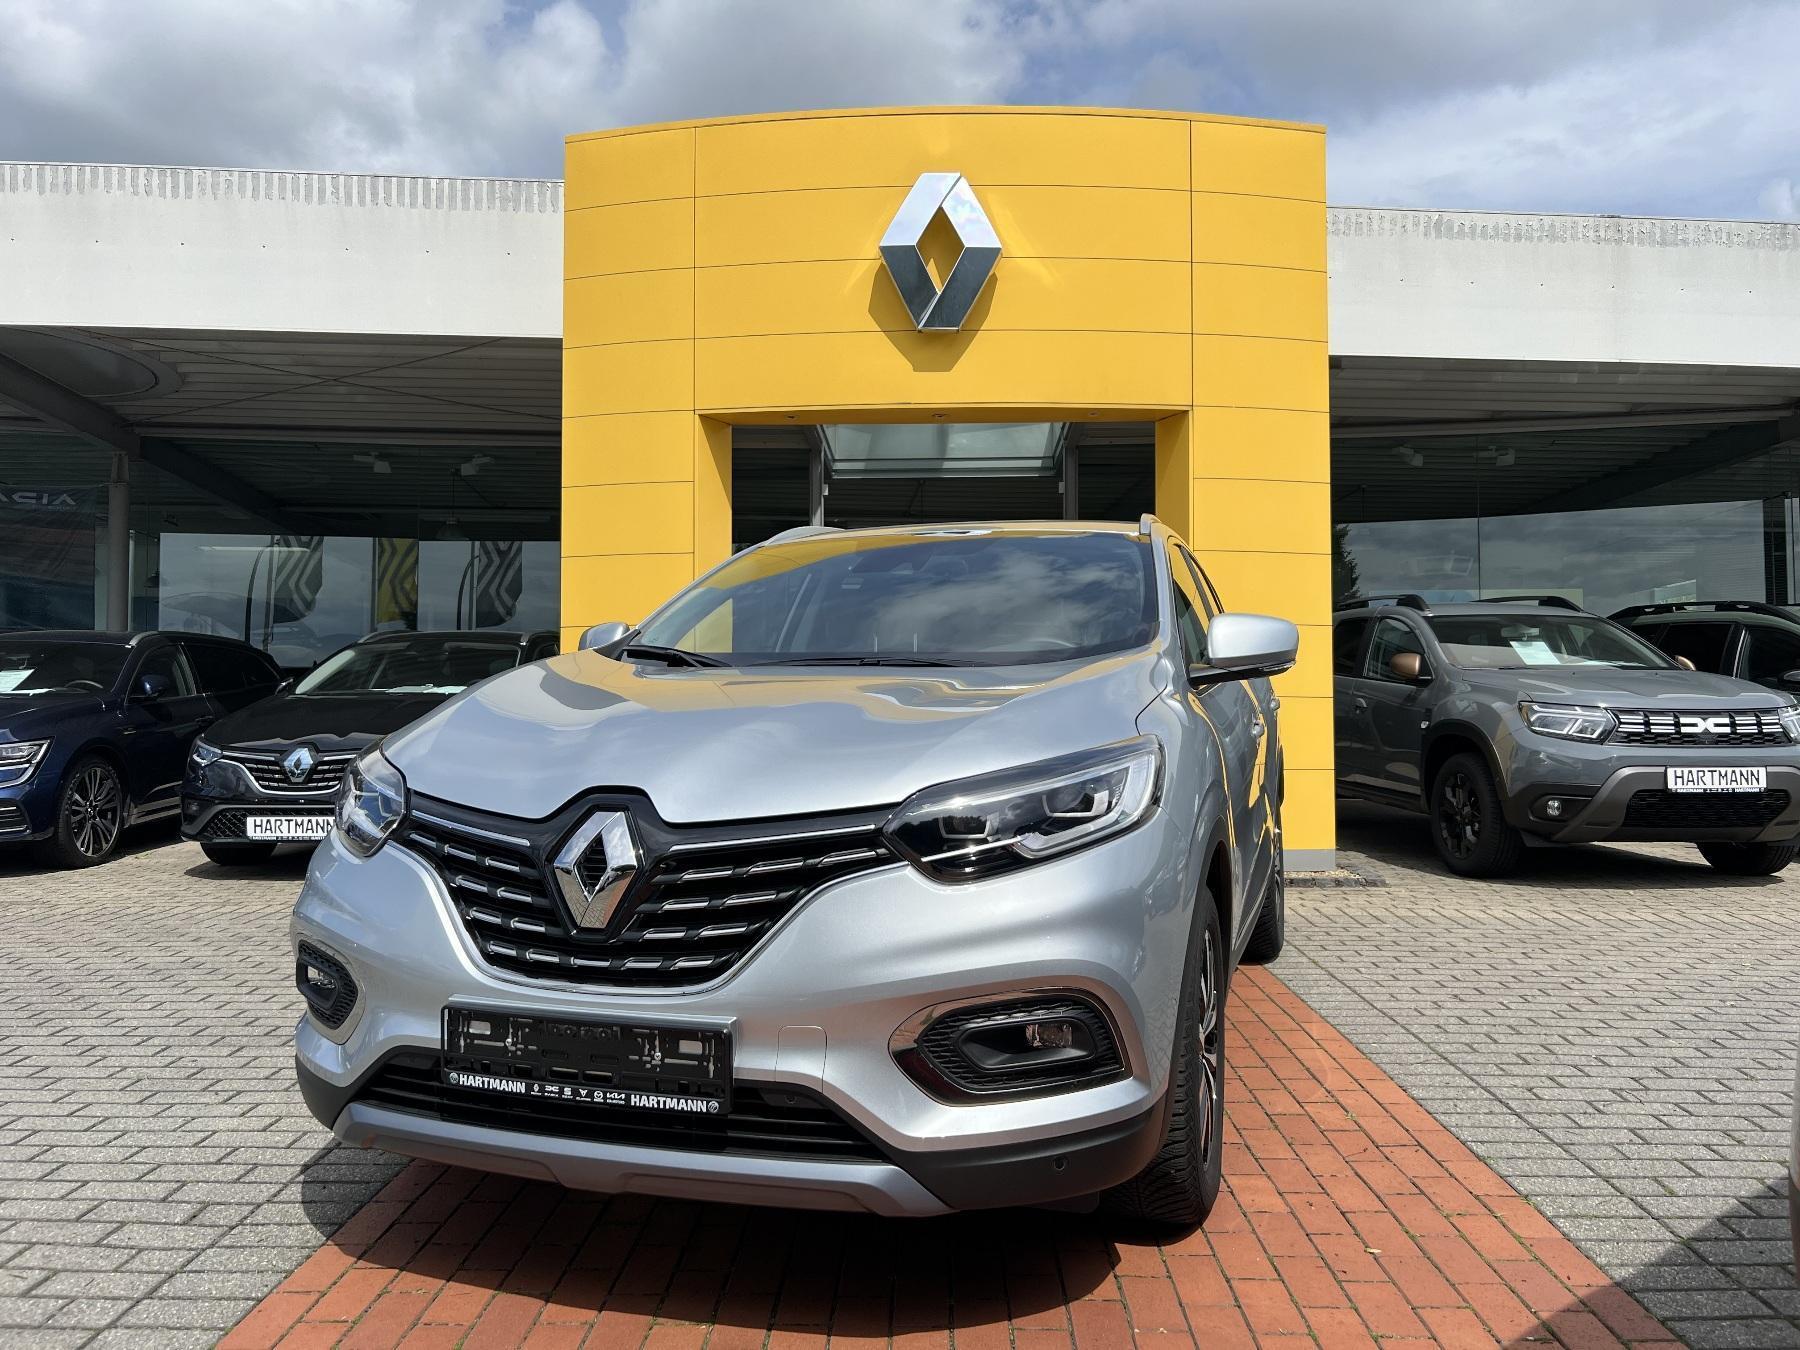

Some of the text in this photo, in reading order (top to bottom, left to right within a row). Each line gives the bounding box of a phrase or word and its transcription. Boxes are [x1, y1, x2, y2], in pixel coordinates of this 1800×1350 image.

[1673, 769, 1760, 786] HARTMANN
[459, 1073, 526, 1094] HARTMANN
[630, 1094, 707, 1113] HARTMANN
